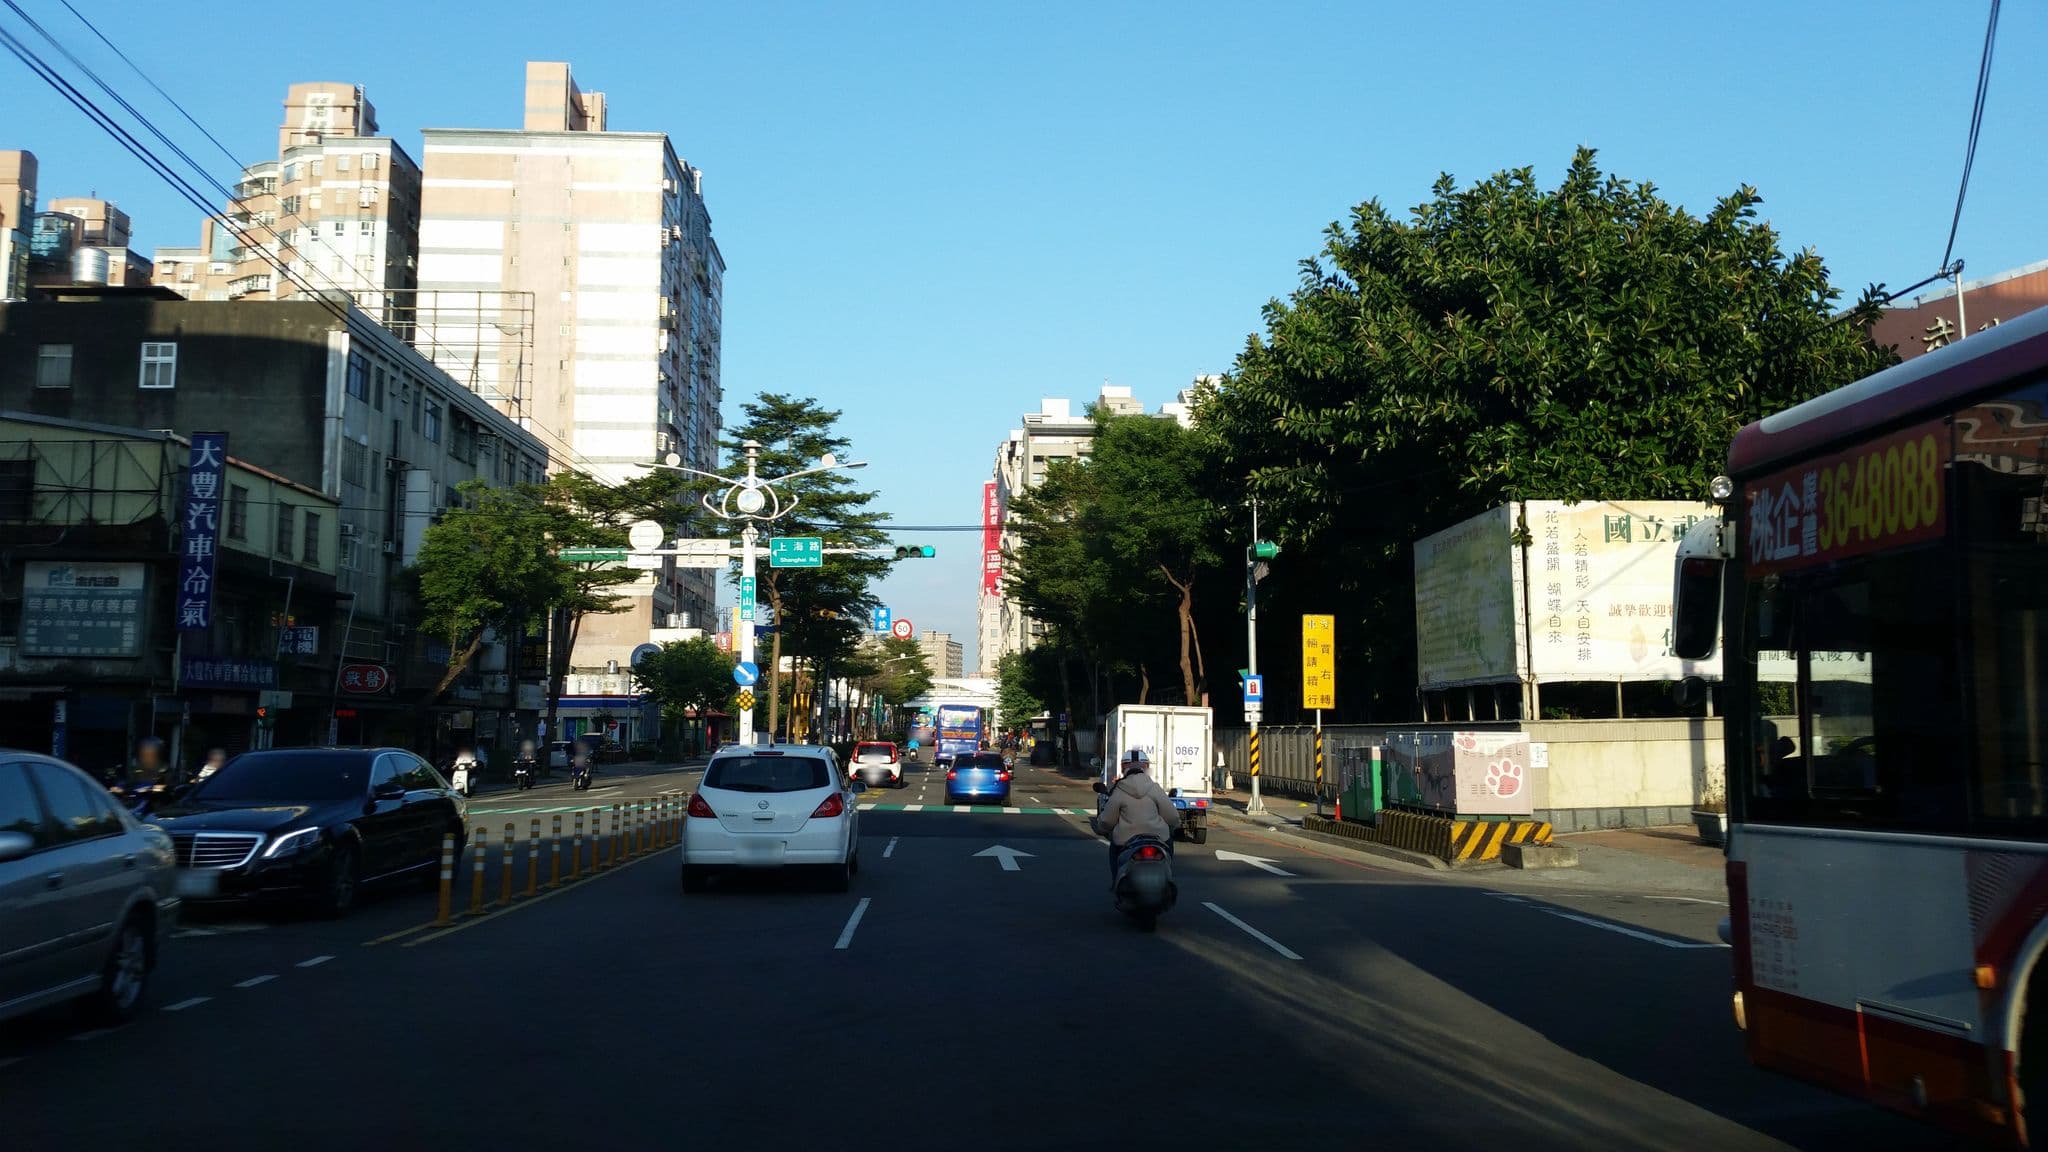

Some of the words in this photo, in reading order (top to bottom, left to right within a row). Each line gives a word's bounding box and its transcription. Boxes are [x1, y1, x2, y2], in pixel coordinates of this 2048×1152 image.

[1749, 481, 1800, 566] 桃企
[1819, 434, 1939, 552] 3648088
[180, 438, 221, 628] 大豐汽車冷氣
[777, 541, 819, 551] 上海路
[1545, 510, 1561, 572] 花若盛開
[1574, 527, 1590, 589] 人若精彩
[1604, 515, 1722, 543] 國立武
[742, 584, 753, 619] 中山路
[898, 624, 908, 633] 50
[1547, 582, 1563, 644] 蝴蝶自來
[1576, 600, 1592, 662] 天自安排
[1175, 746, 1200, 757] 0867
